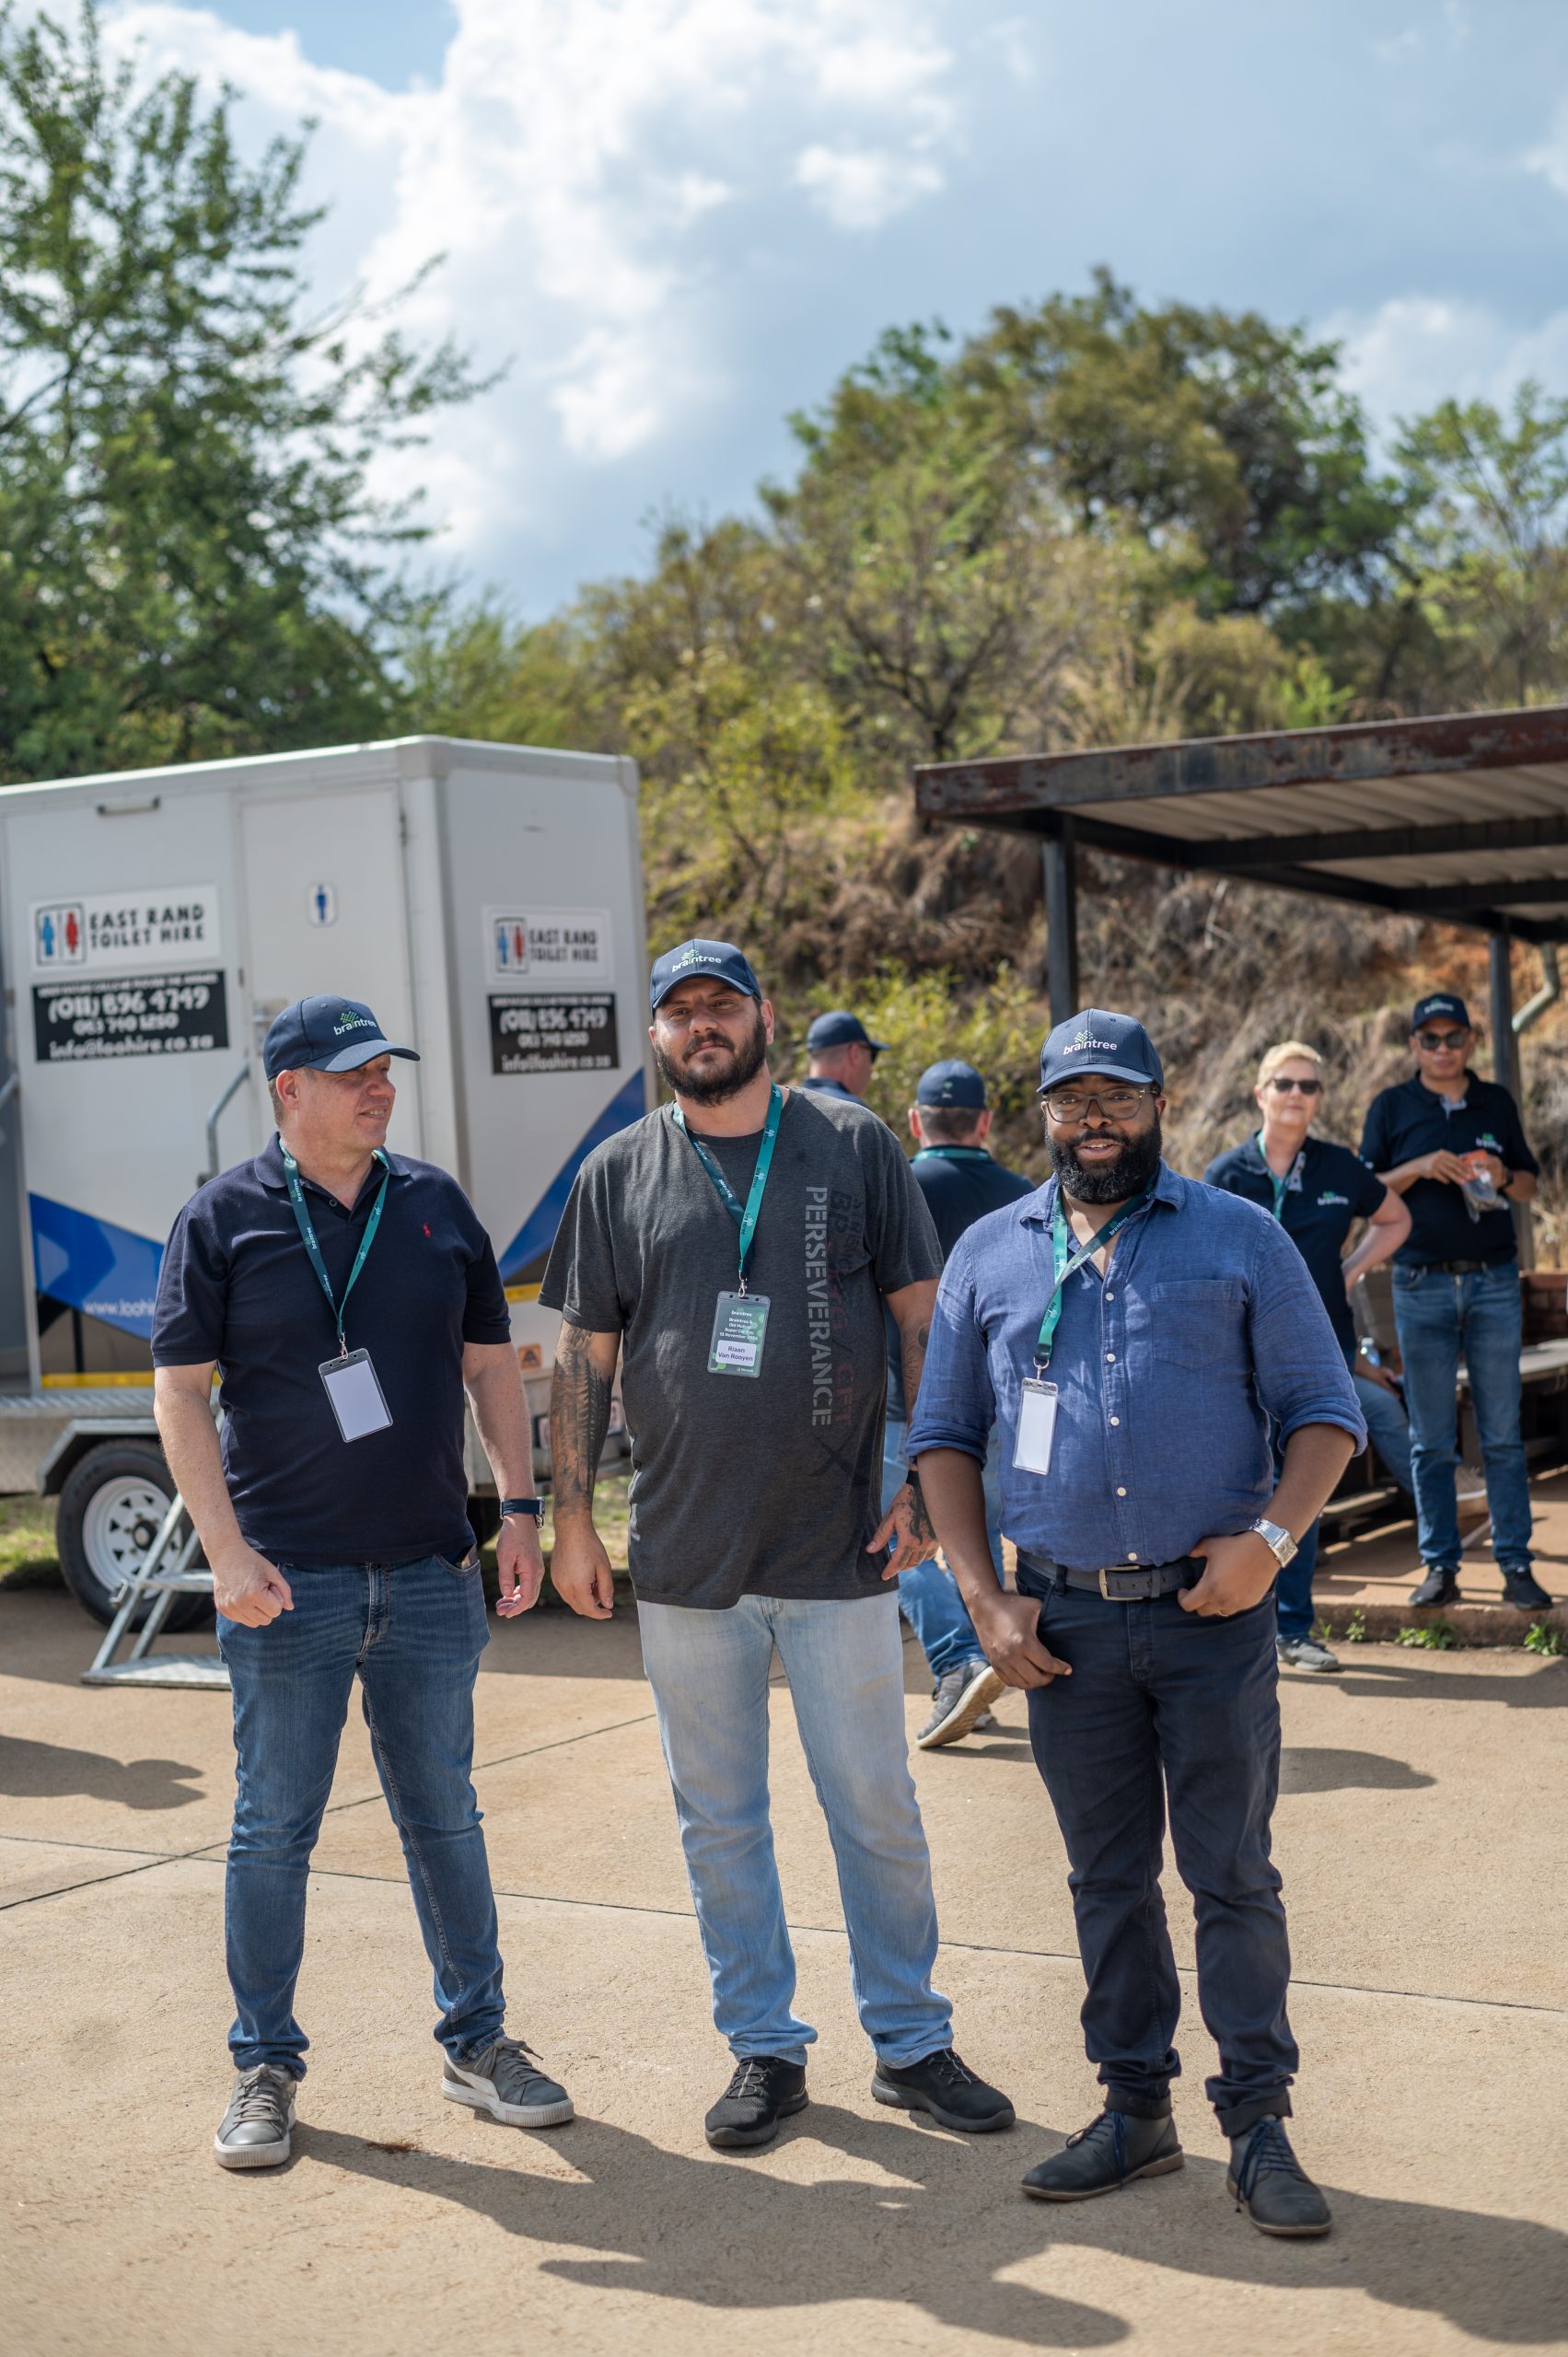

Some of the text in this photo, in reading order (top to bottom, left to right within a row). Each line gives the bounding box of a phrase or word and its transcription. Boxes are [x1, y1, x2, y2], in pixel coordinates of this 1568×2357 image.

[90, 904, 203, 930] EAST RAND
[91, 924, 203, 948] TOILET HIRE
[529, 928, 559, 944] EAST
[672, 954, 722, 972] braintree
[48, 995, 99, 1023] (011)
[149, 986, 210, 1012] 4749
[333, 1017, 377, 1035] braintree
[1063, 1039, 1118, 1055] braintree
[806, 1187, 833, 1426] PERSEVERANCE
